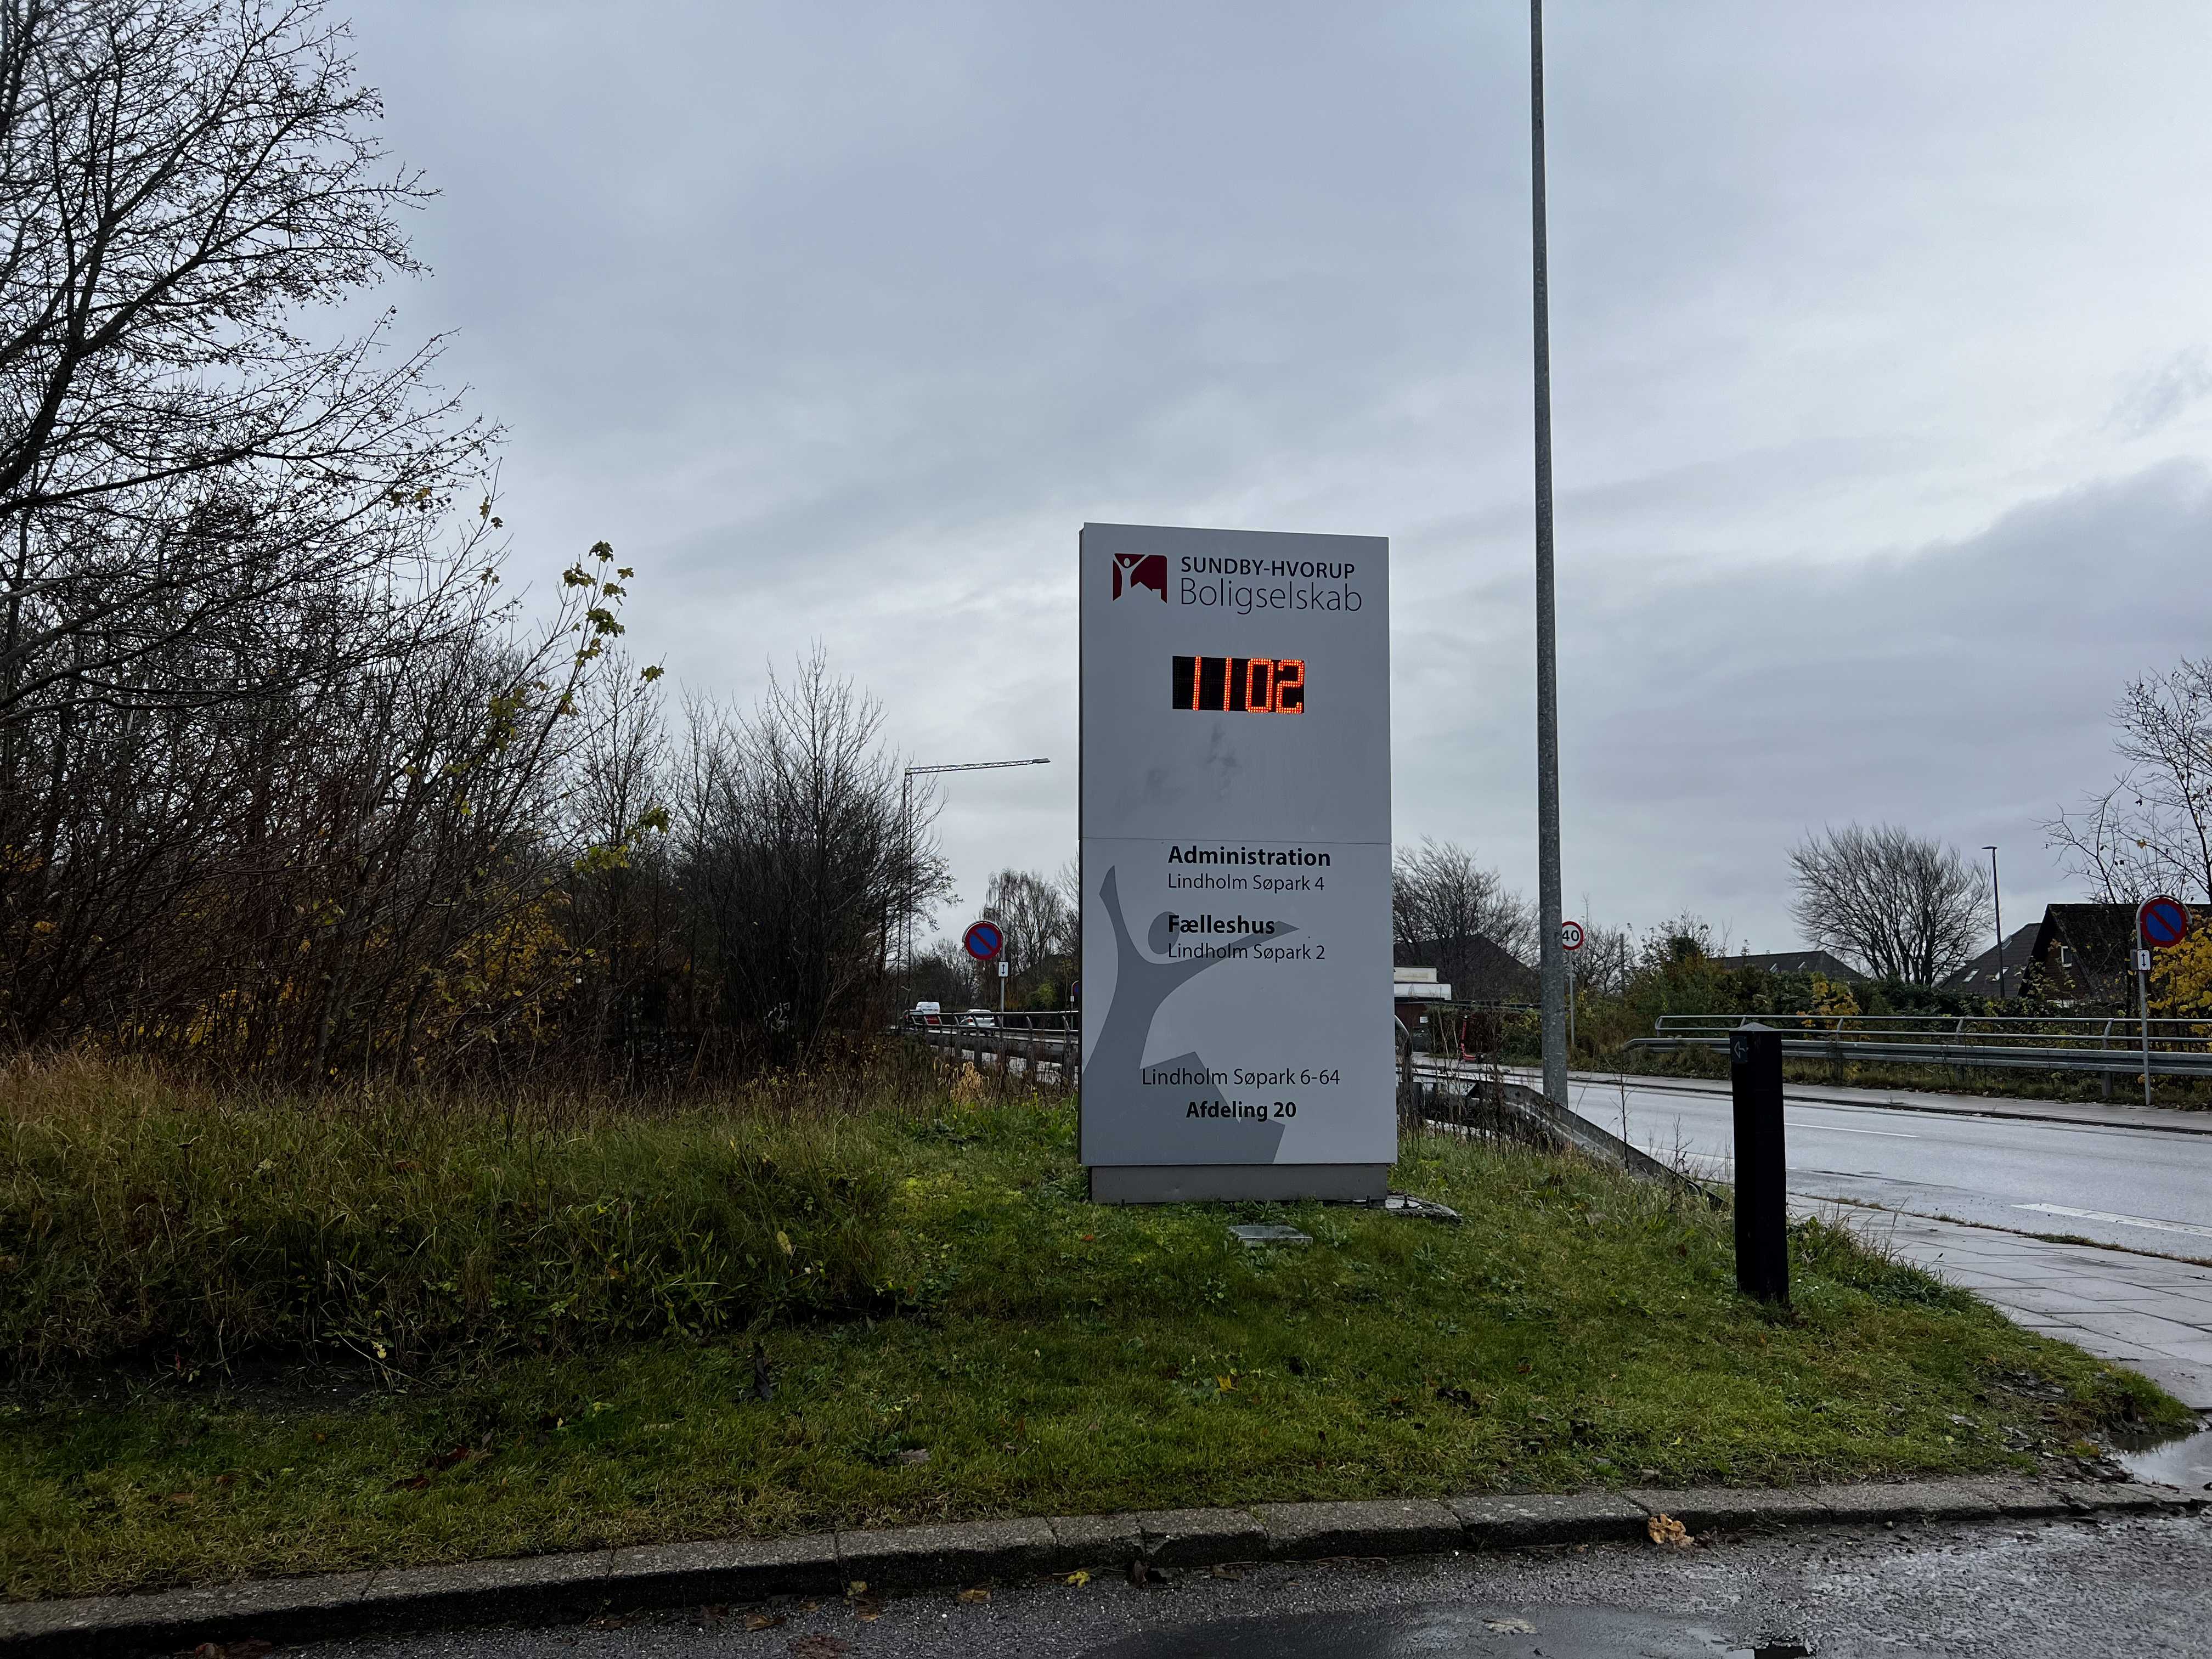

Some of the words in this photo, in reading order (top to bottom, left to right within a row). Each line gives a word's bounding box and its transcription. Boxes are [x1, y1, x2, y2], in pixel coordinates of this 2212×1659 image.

[1181, 556, 1355, 578] SUNDBY-HVORUP
[1181, 578, 1362, 614] Boligselskab
[1192, 656, 1305, 714] 1102
[1167, 845, 1330, 866] Administration
[1169, 873, 1247, 889] Lindholm
[1253, 874, 1311, 894] Søpark
[1314, 877, 1325, 891] 4
[1168, 915, 1275, 934] Fælleshus
[1562, 930, 1579, 941] 40
[1169, 943, 1248, 958] Lindholm
[1254, 944, 1311, 963] Søpark
[1316, 945, 1325, 960] 2
[1142, 1068, 1227, 1085] Lindholm
[1234, 1068, 1296, 1089] Søpark
[1300, 1068, 1340, 1085] 6-64
[1186, 1101, 1268, 1122] Afdeling
[1273, 1102, 1296, 1118] 20
